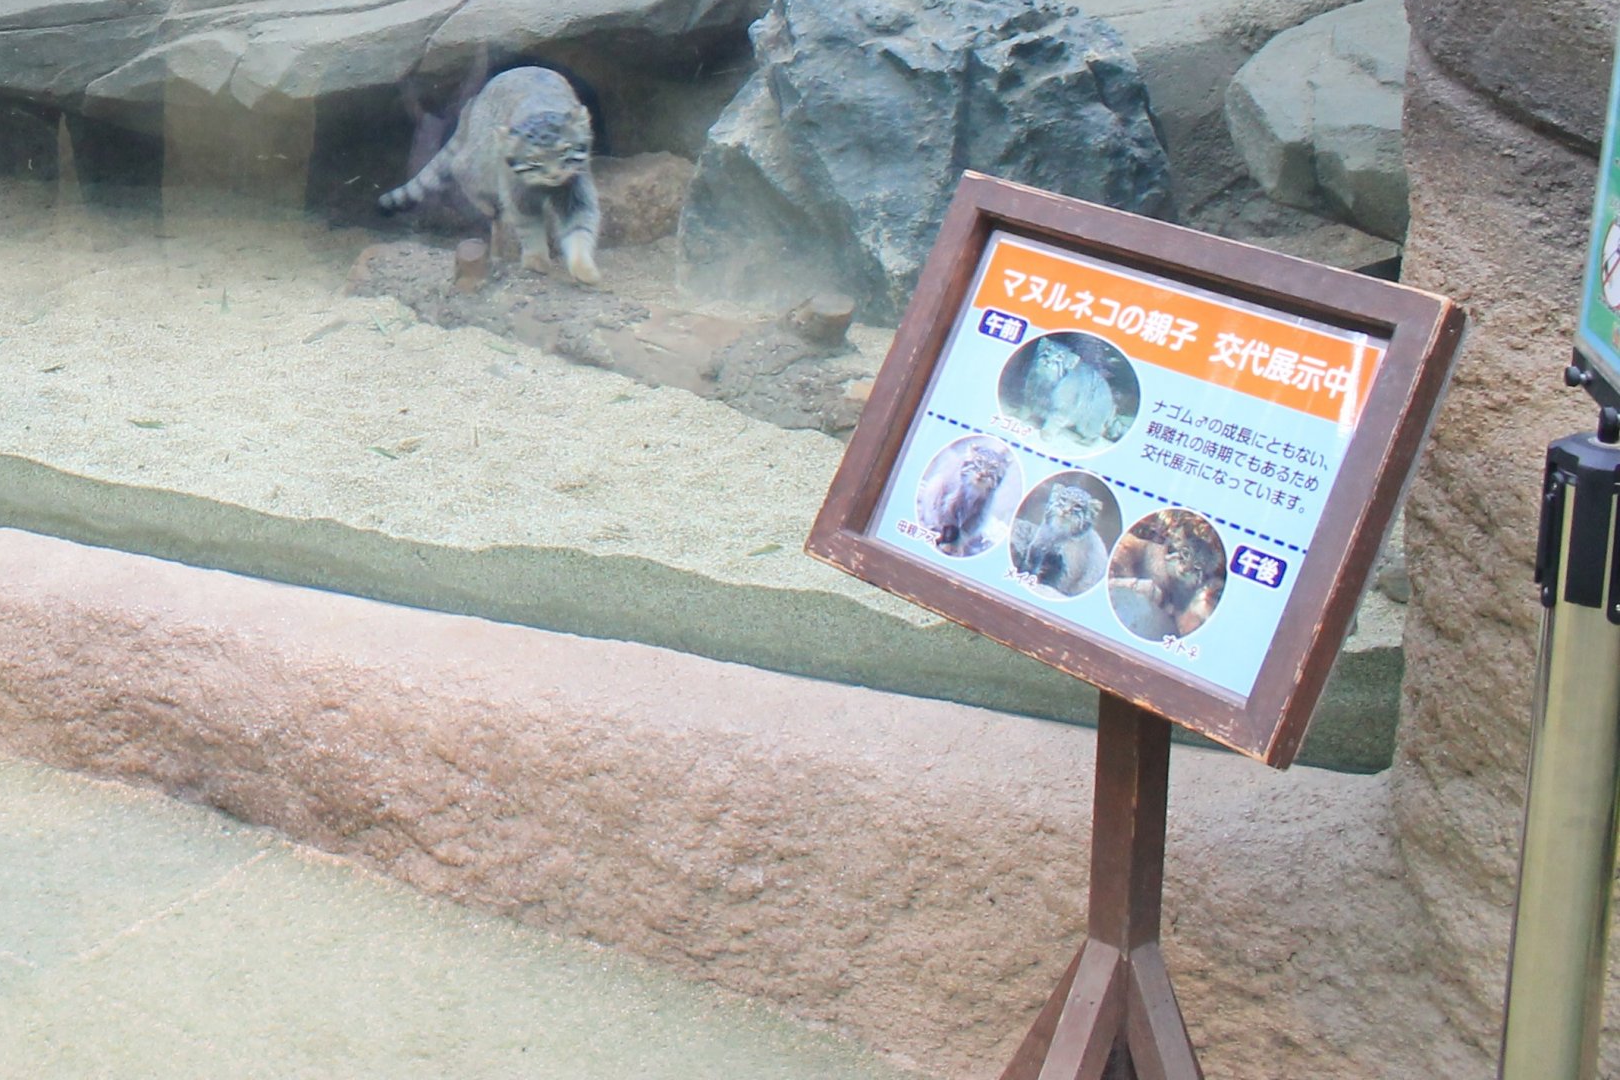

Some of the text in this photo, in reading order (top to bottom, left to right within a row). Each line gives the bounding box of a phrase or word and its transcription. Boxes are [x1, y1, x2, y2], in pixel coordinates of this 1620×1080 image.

[985, 312, 1023, 341] 午前
[1003, 269, 1354, 399] マヌルネコの親子 交代展示中
[1140, 443, 1305, 514] 交代展示になっています。
[1145, 421, 1319, 492] 親離れの時期でもあるため
[1238, 549, 1280, 585] 午後
